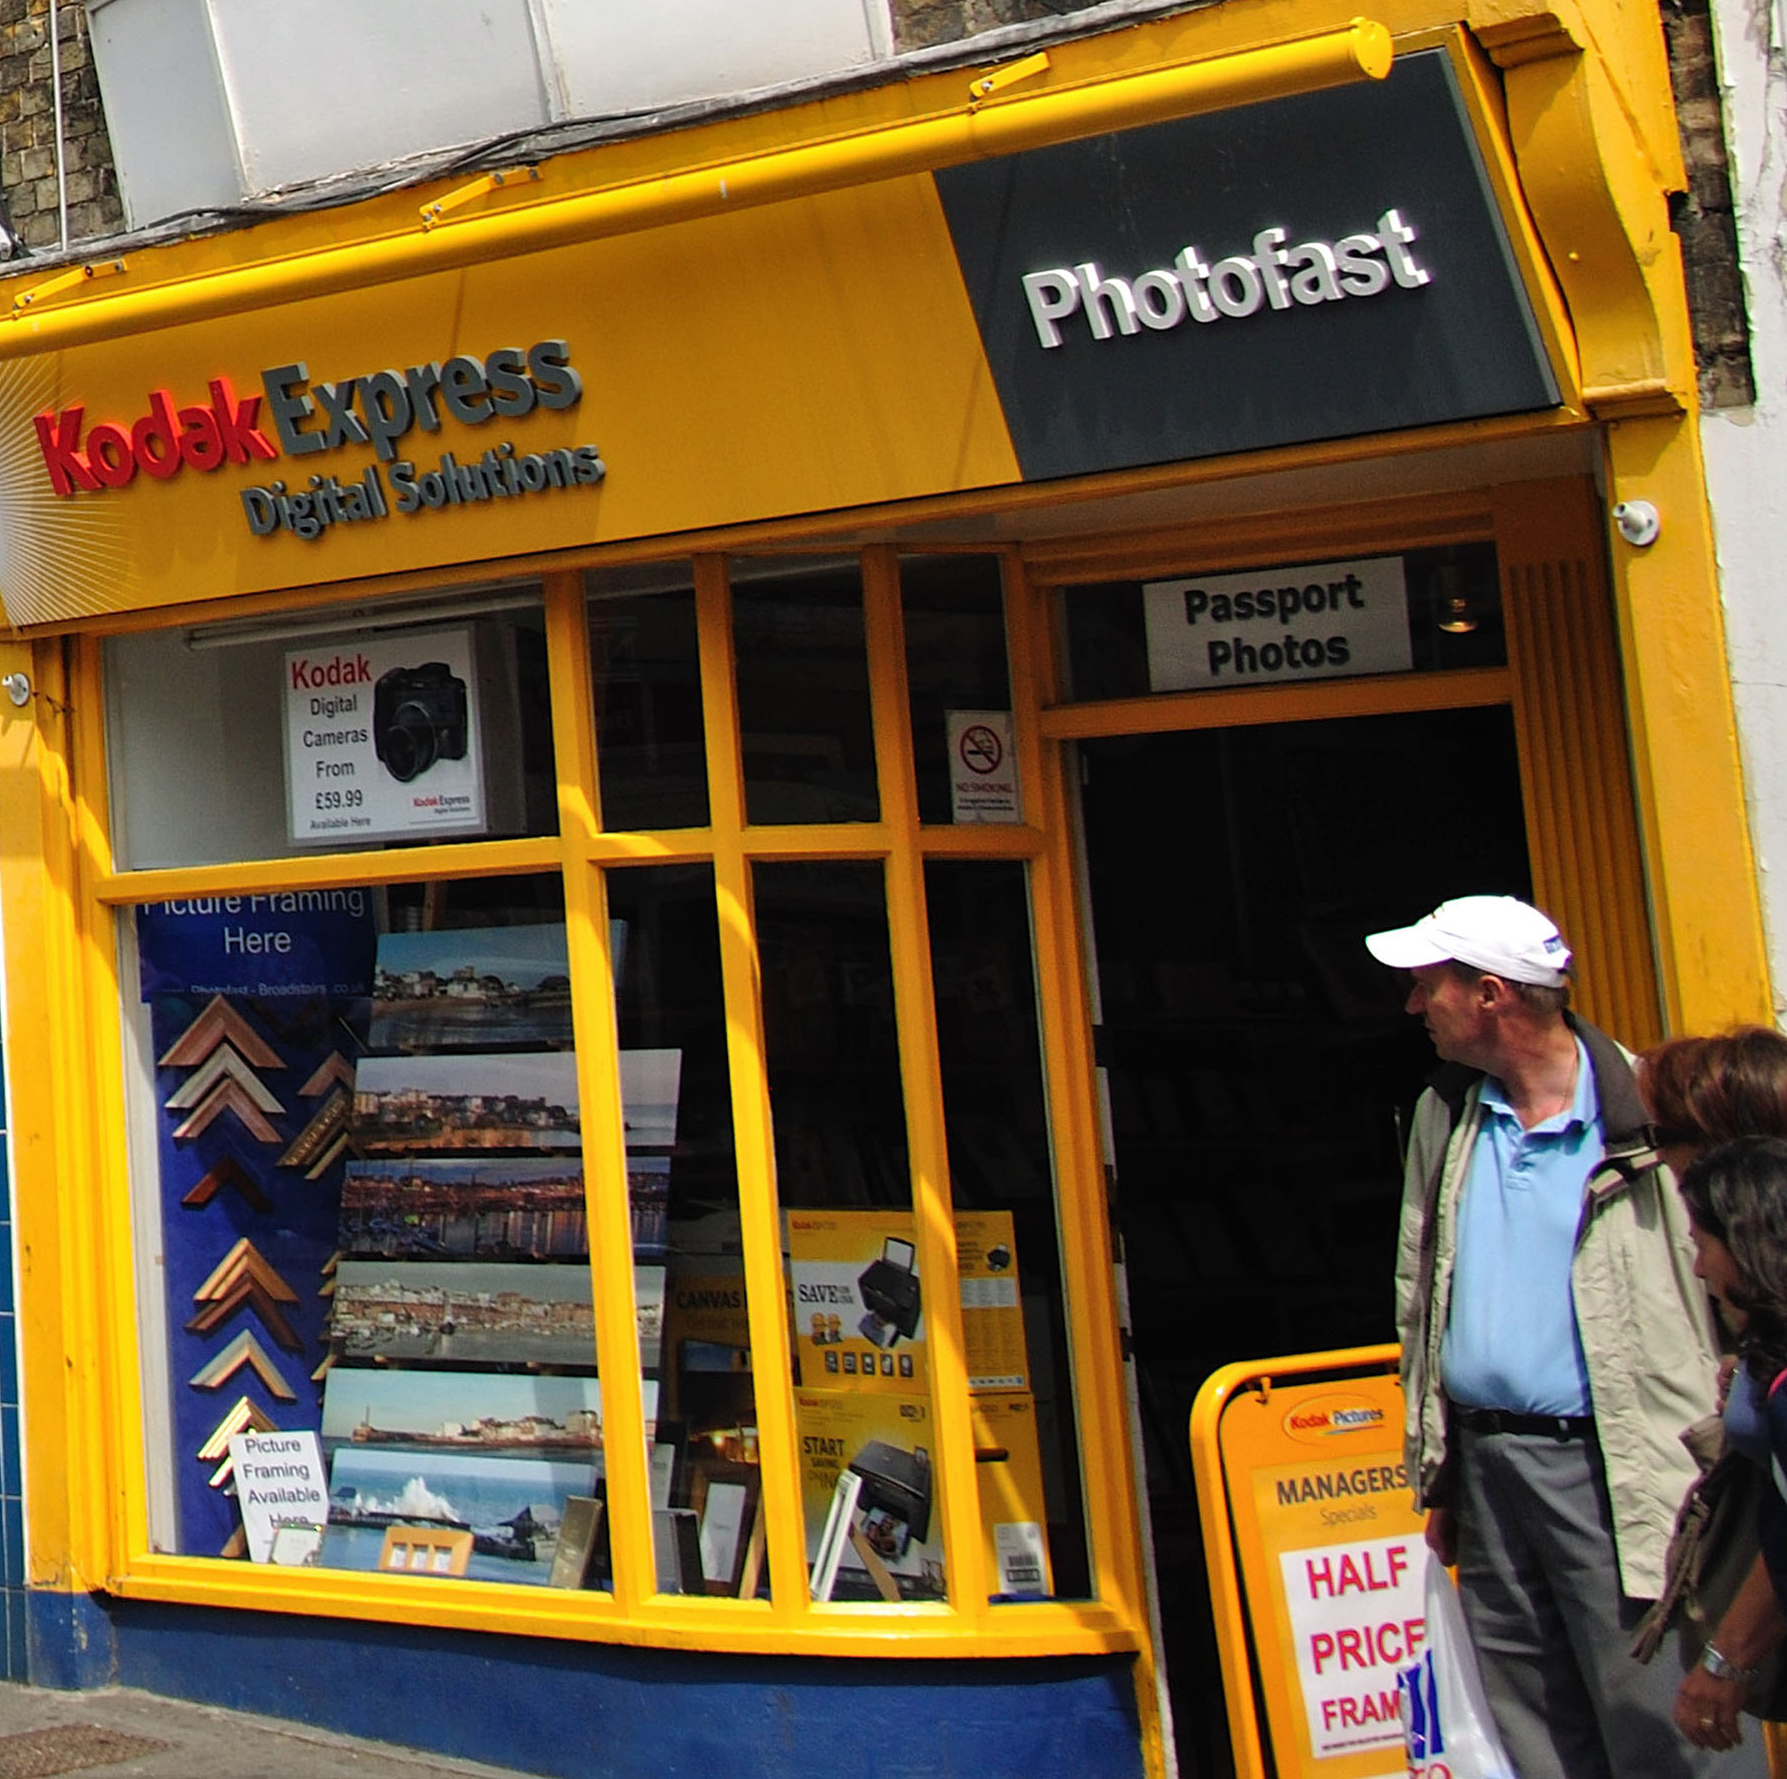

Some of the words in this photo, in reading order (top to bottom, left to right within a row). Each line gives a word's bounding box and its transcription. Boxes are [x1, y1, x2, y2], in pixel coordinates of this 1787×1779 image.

[1023, 209, 1433, 350] Photofast
[32, 375, 278, 497] Kodak
[261, 339, 582, 460] Express
[240, 465, 387, 540] Digital
[389, 442, 606, 516] Solutions
[1183, 572, 1365, 626] Passport
[1207, 629, 1350, 676] Photos
[291, 654, 372, 690] Kodak
[310, 694, 358, 719] Digital
[303, 728, 368, 748] Cameras
[315, 760, 355, 779] From
[315, 789, 363, 810] £59.99
[309, 819, 349, 830] Available
[350, 817, 371, 828] Here
[224, 927, 291, 954] Here
[799, 1284, 838, 1304] SAVE
[1290, 1413, 1330, 1430] Kodak
[1332, 1408, 1384, 1426] Pictures
[244, 1438, 302, 1454] Picture
[803, 1436, 843, 1457] START
[242, 1462, 309, 1480] Framing
[248, 1487, 320, 1504] Available
[1277, 1465, 1409, 1505] MANAGERS
[1320, 1504, 1377, 1527] Specials
[1306, 1545, 1407, 1600] HALF
